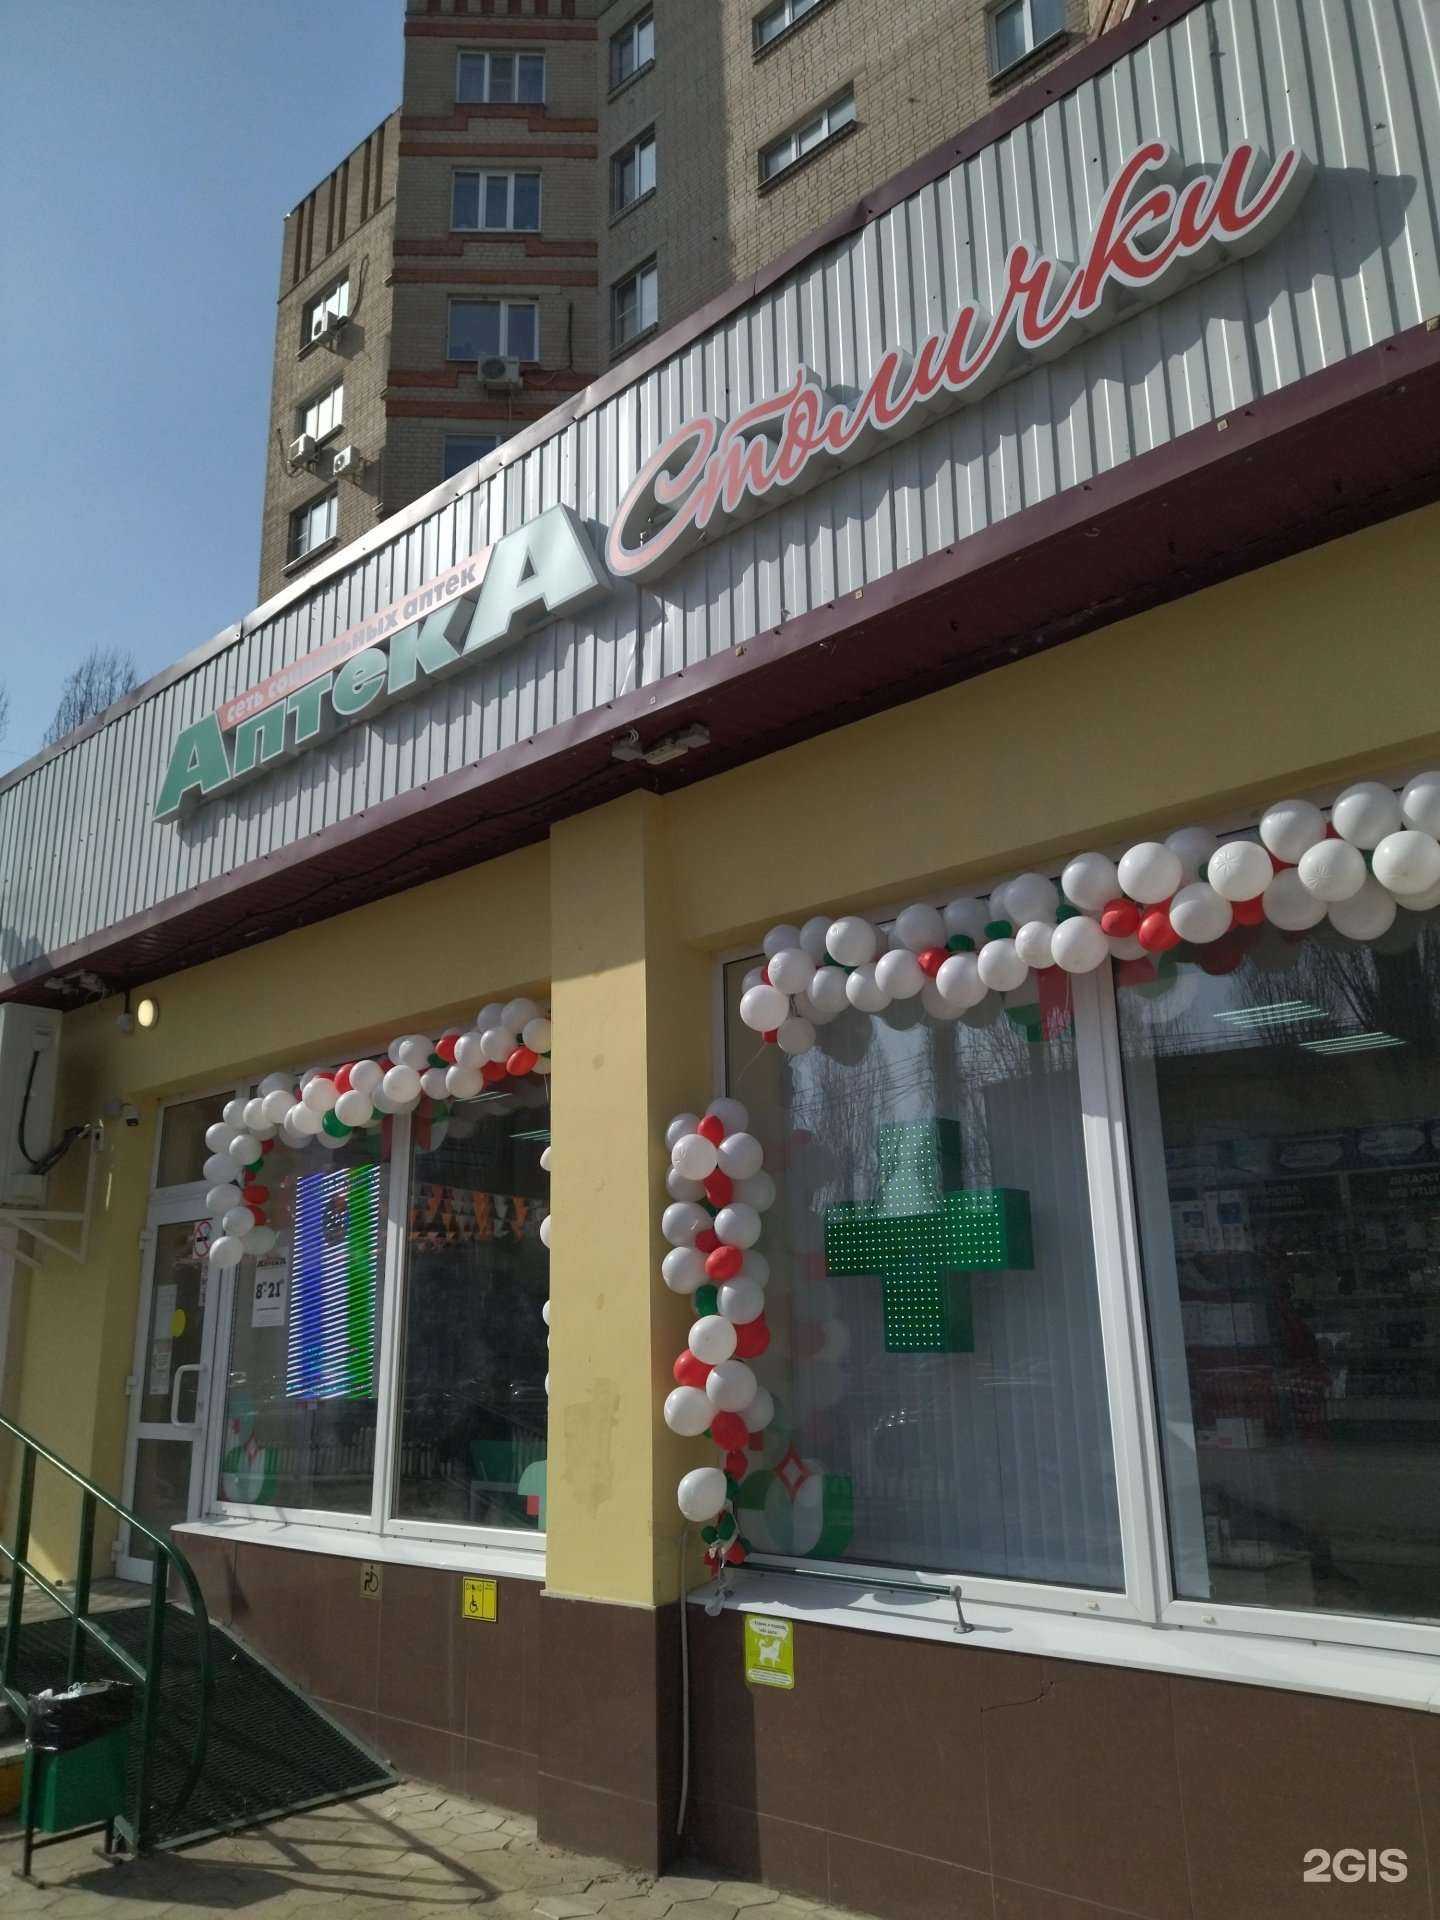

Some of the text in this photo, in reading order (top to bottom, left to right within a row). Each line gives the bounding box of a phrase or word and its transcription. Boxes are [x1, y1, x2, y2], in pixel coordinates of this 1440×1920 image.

[606, 139, 1301, 577] Столички
[225, 563, 477, 723] сеть соцьных аптек
